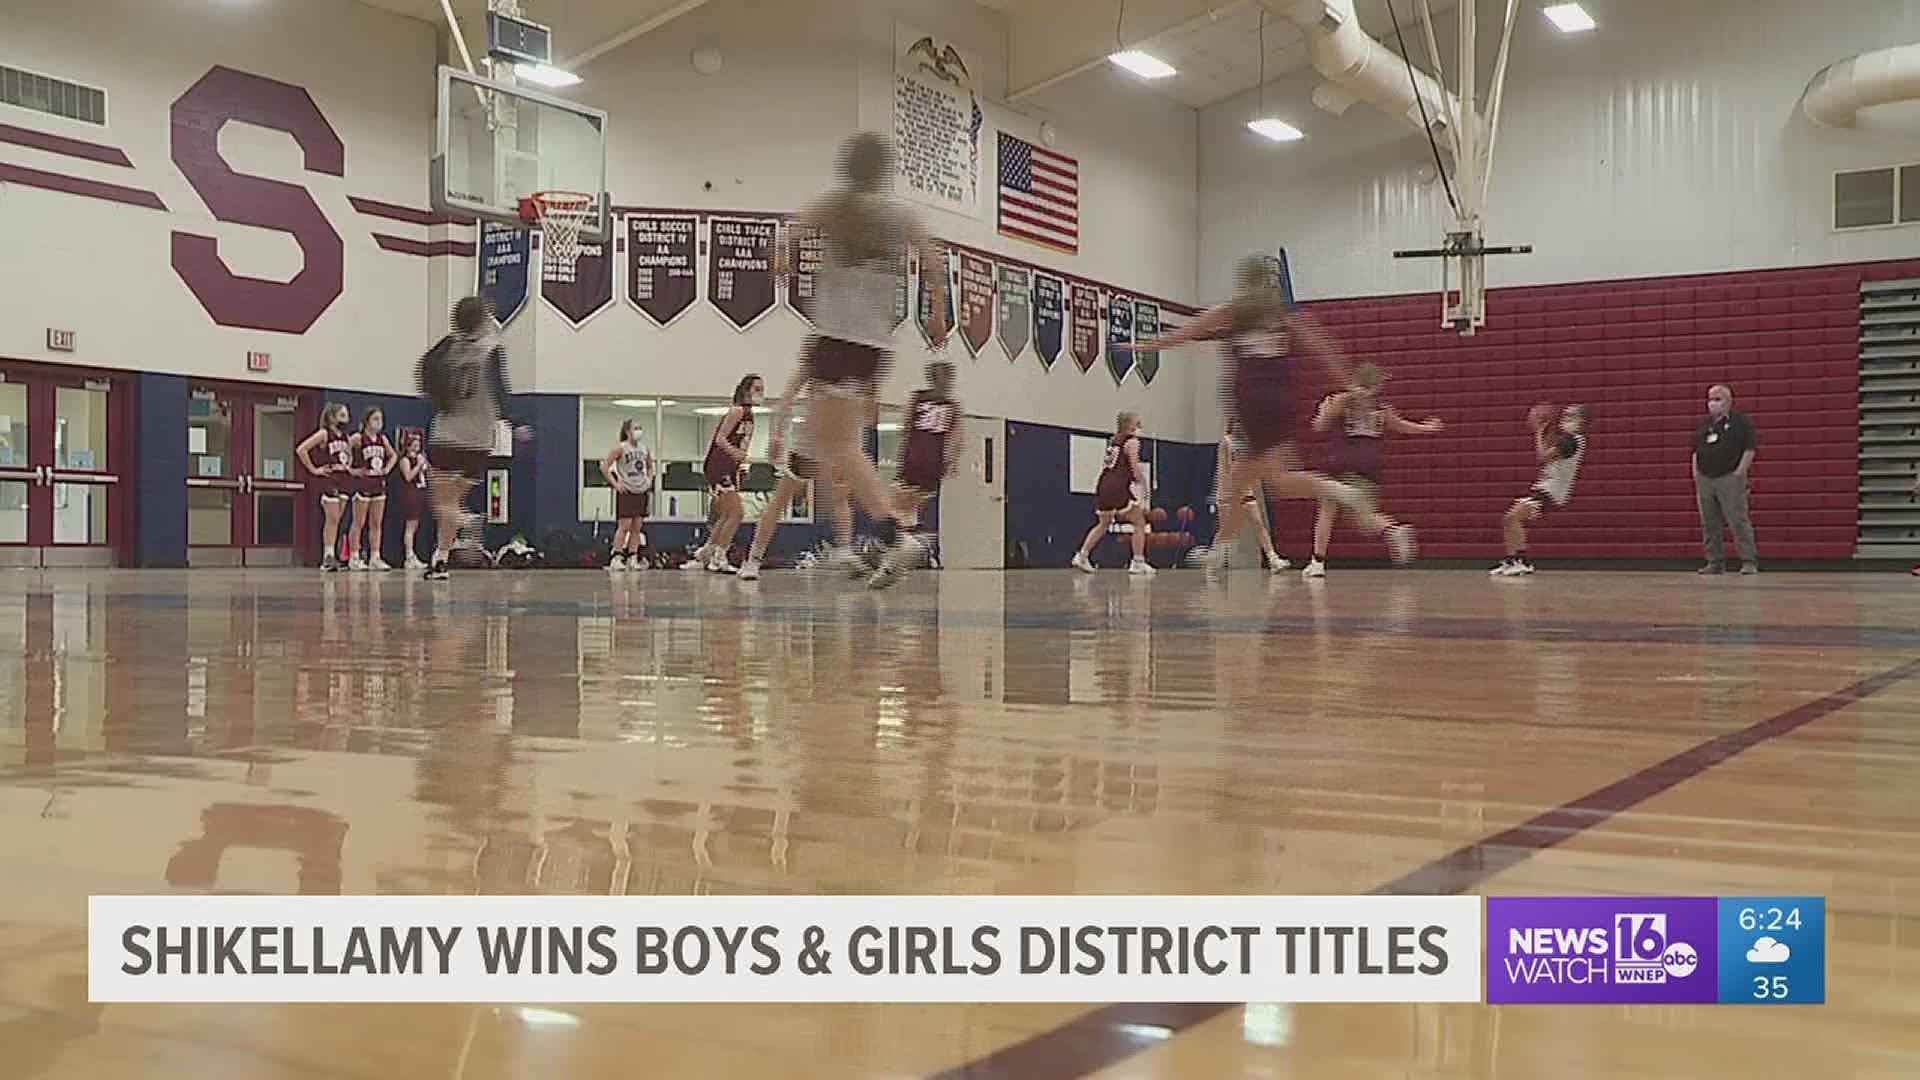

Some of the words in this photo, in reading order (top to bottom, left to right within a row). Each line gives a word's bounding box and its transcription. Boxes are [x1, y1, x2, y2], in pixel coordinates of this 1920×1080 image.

[169, 64, 344, 335] S
[632, 220, 658, 231] GIRLS
[638, 232, 676, 244] DISTRICT
[719, 235, 757, 247] DISTRICT
[638, 255, 688, 266] CHAMPIONS
[718, 257, 769, 270] CHAMPIONS
[54, 329, 74, 347] EXIT
